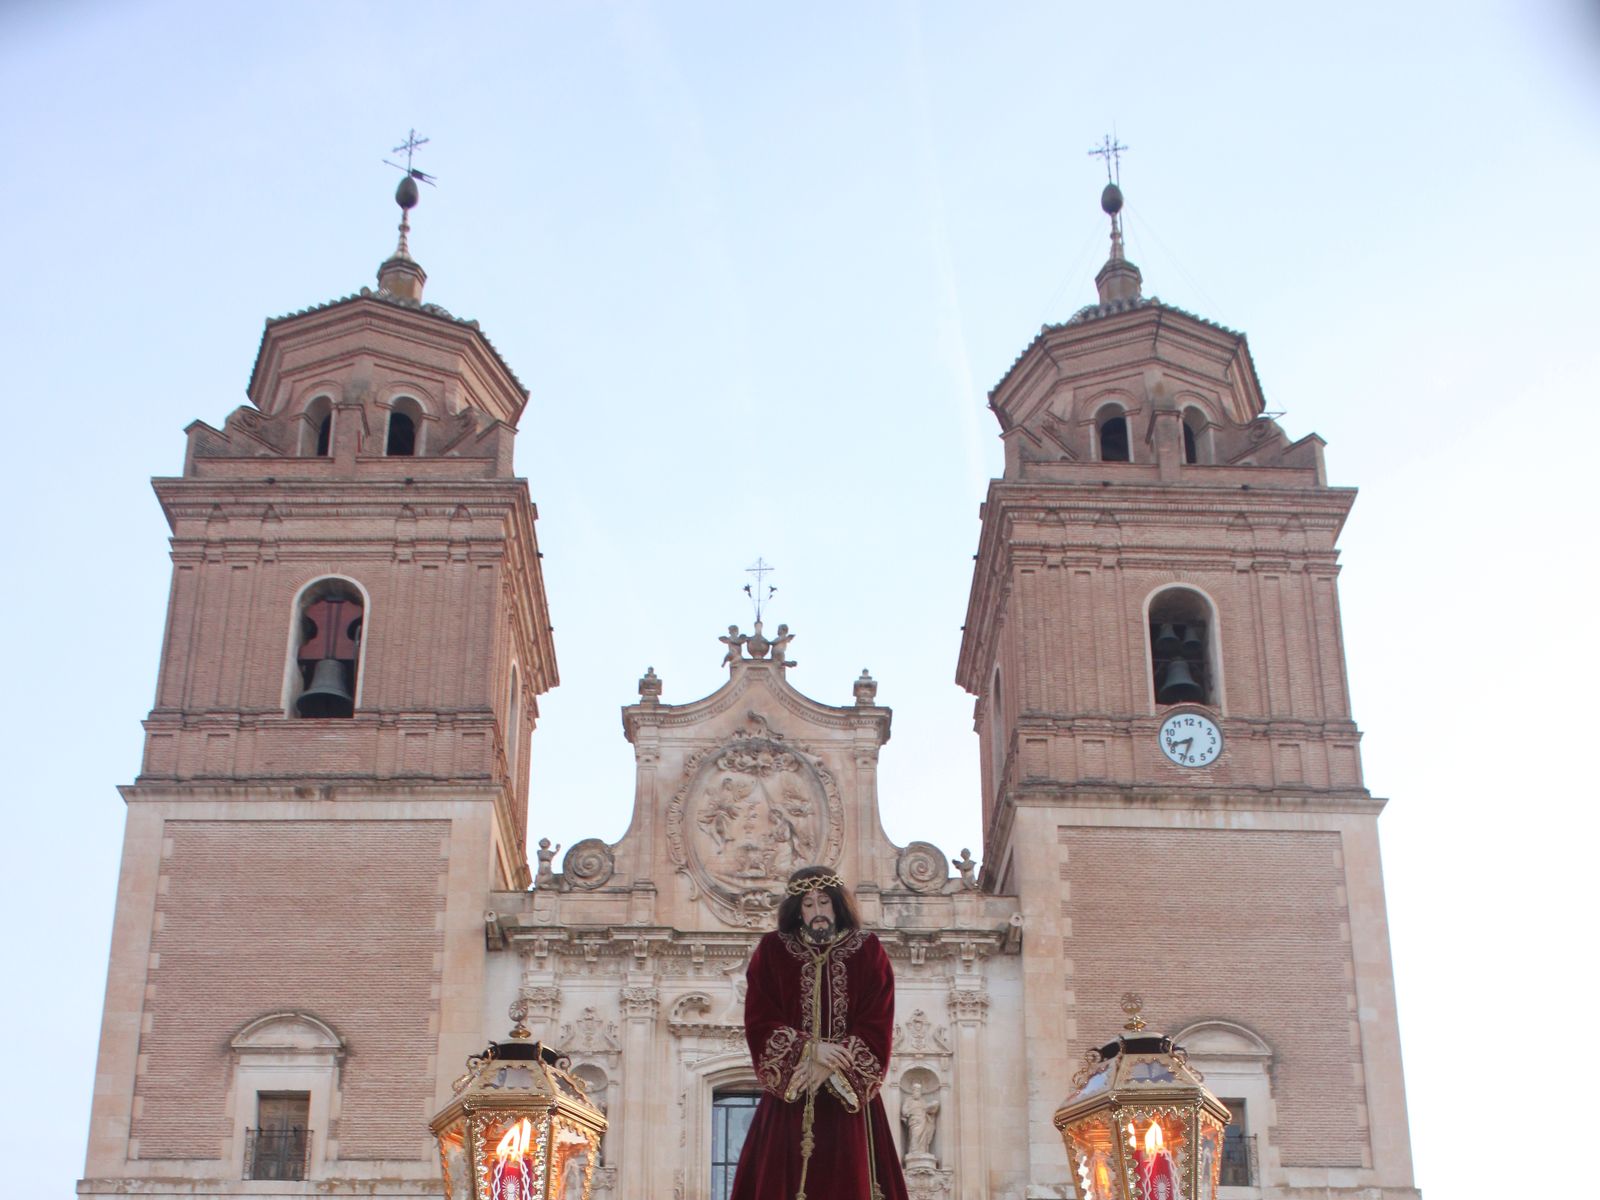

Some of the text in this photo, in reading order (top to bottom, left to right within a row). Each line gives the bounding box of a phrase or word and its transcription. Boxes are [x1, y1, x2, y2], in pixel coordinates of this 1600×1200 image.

[1172, 720, 1181, 728] 11
[1184, 718, 1194, 727] 12
[1165, 728, 1175, 737] 10
[1206, 727, 1212, 736] 2
[1210, 736, 1216, 745] 3
[1189, 755, 1195, 763] 6
[1200, 753, 1206, 761] 5
